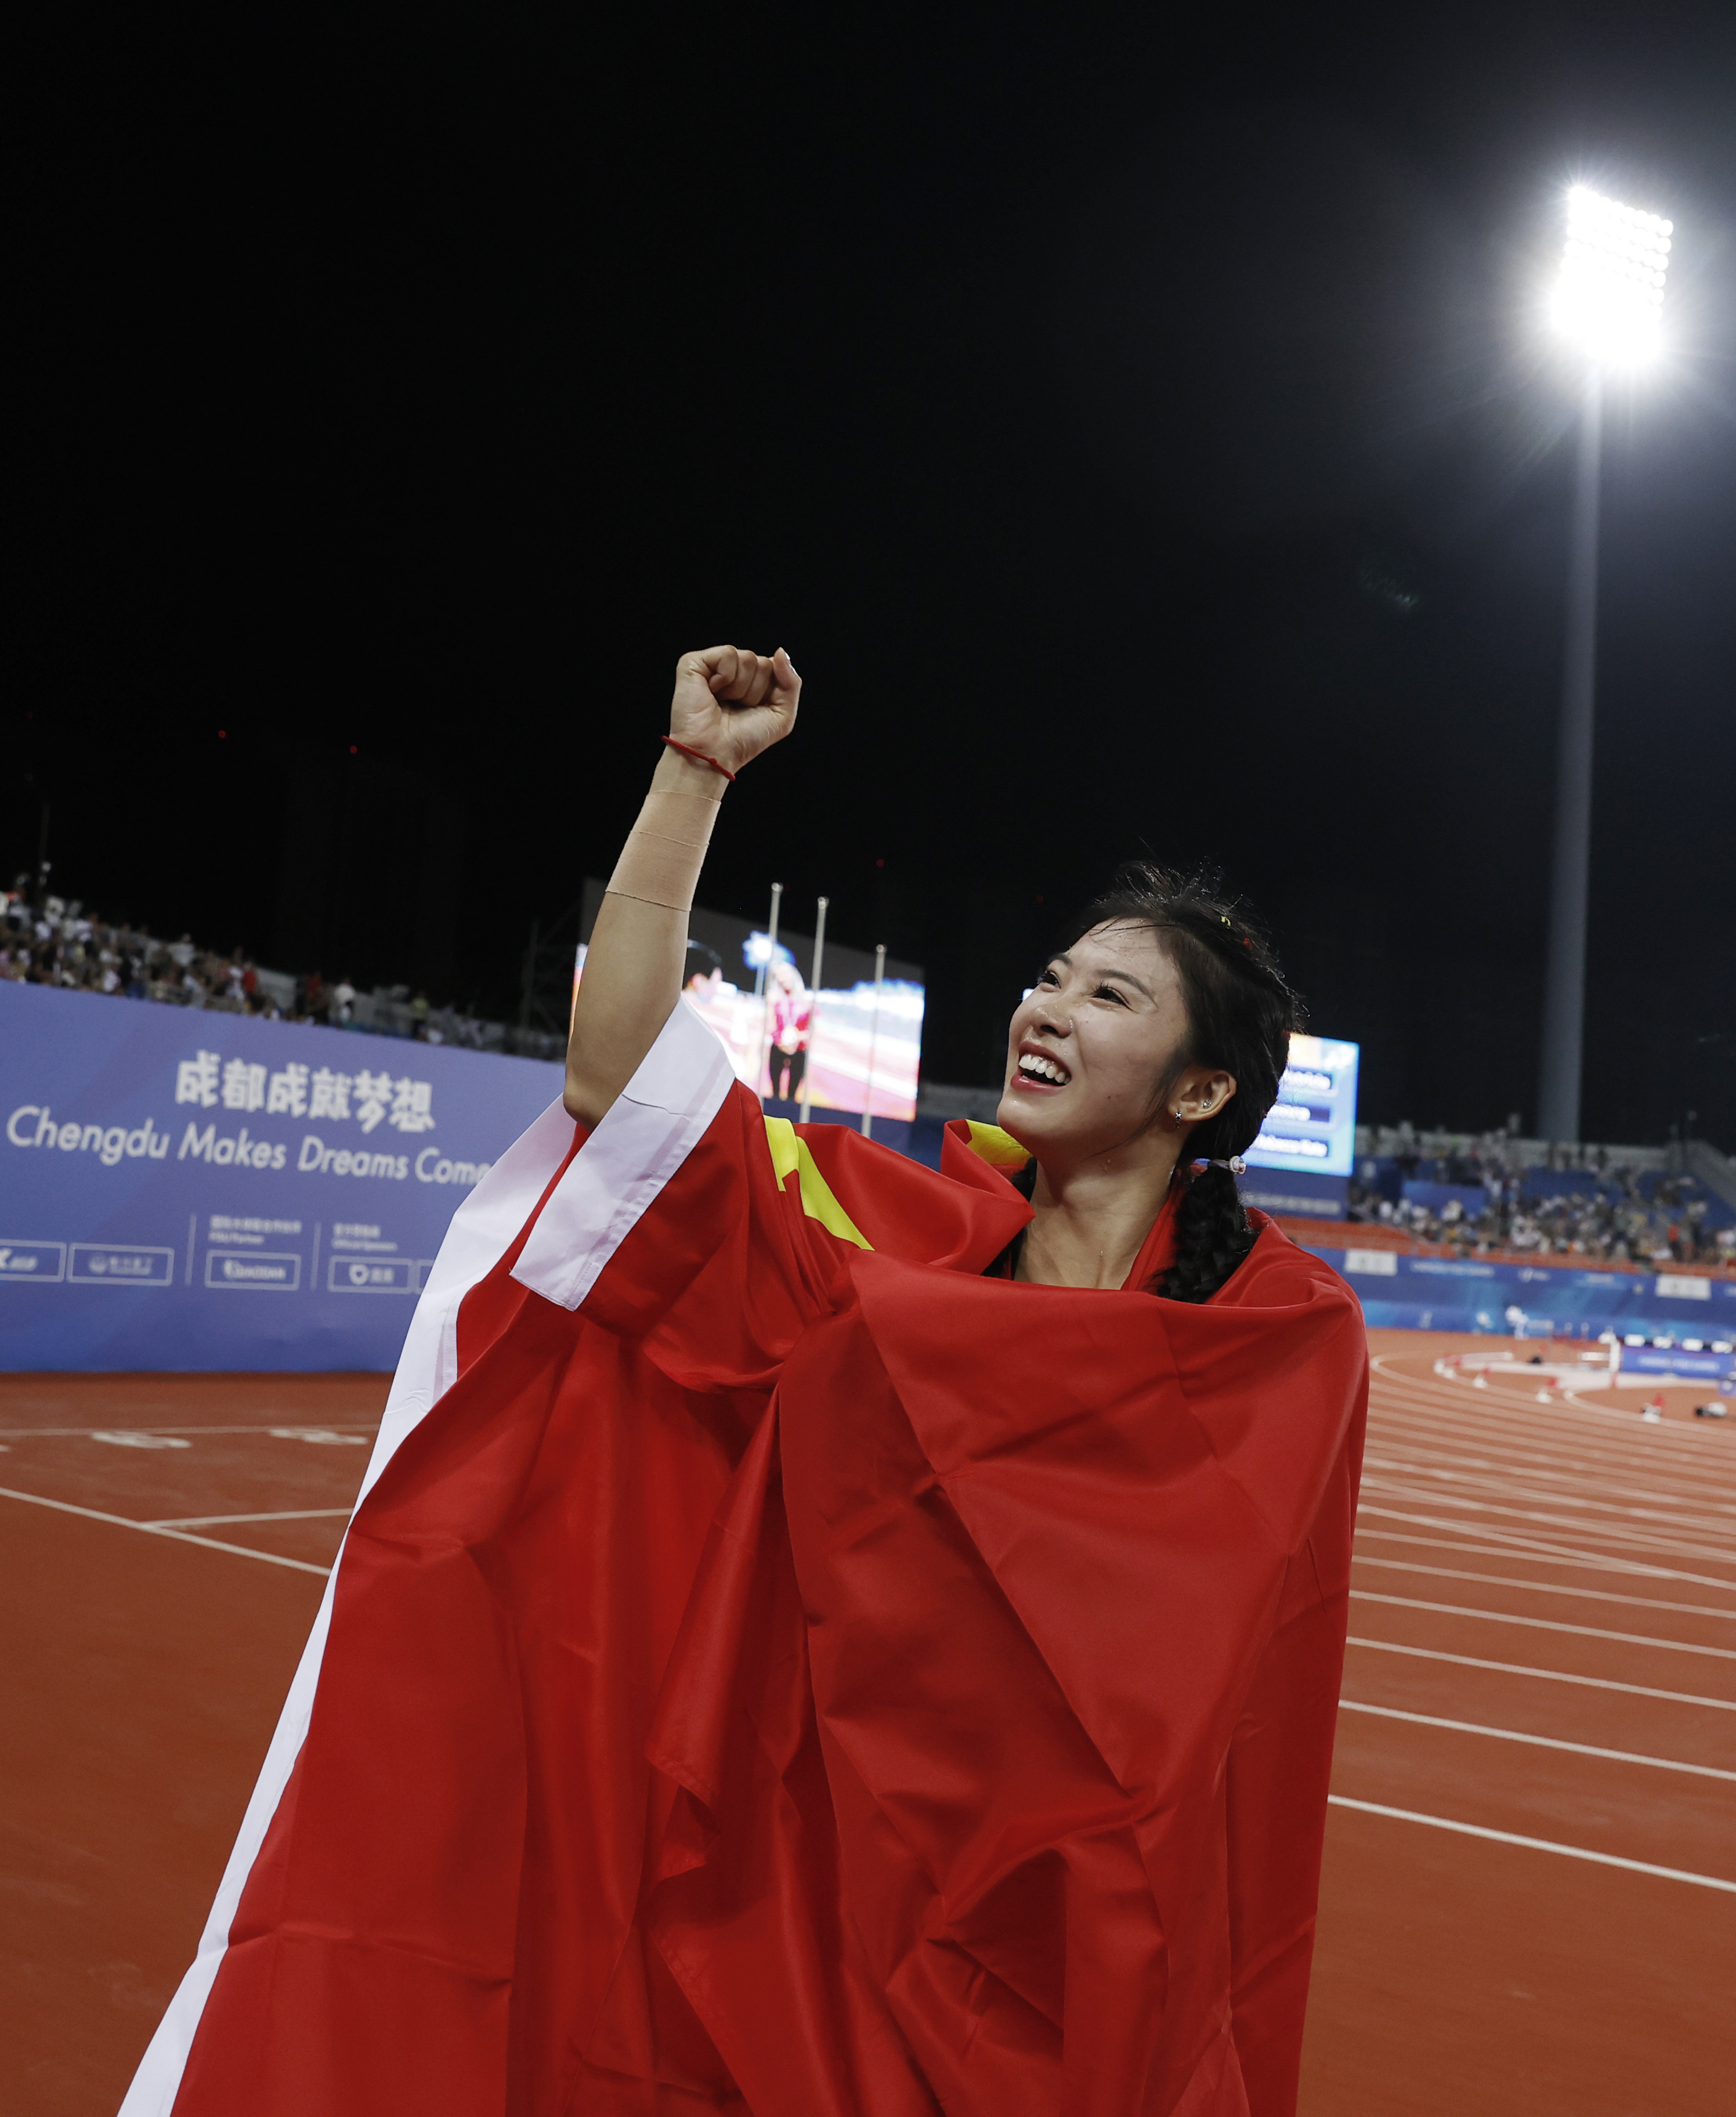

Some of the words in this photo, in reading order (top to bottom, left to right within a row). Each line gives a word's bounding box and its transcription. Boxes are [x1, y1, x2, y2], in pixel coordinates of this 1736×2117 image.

[175, 1049, 436, 1134] 成都成就梦想
[6, 1104, 171, 1166] Chengdu
[176, 1121, 287, 1170] Makes
[297, 1135, 409, 1180] Dreams
